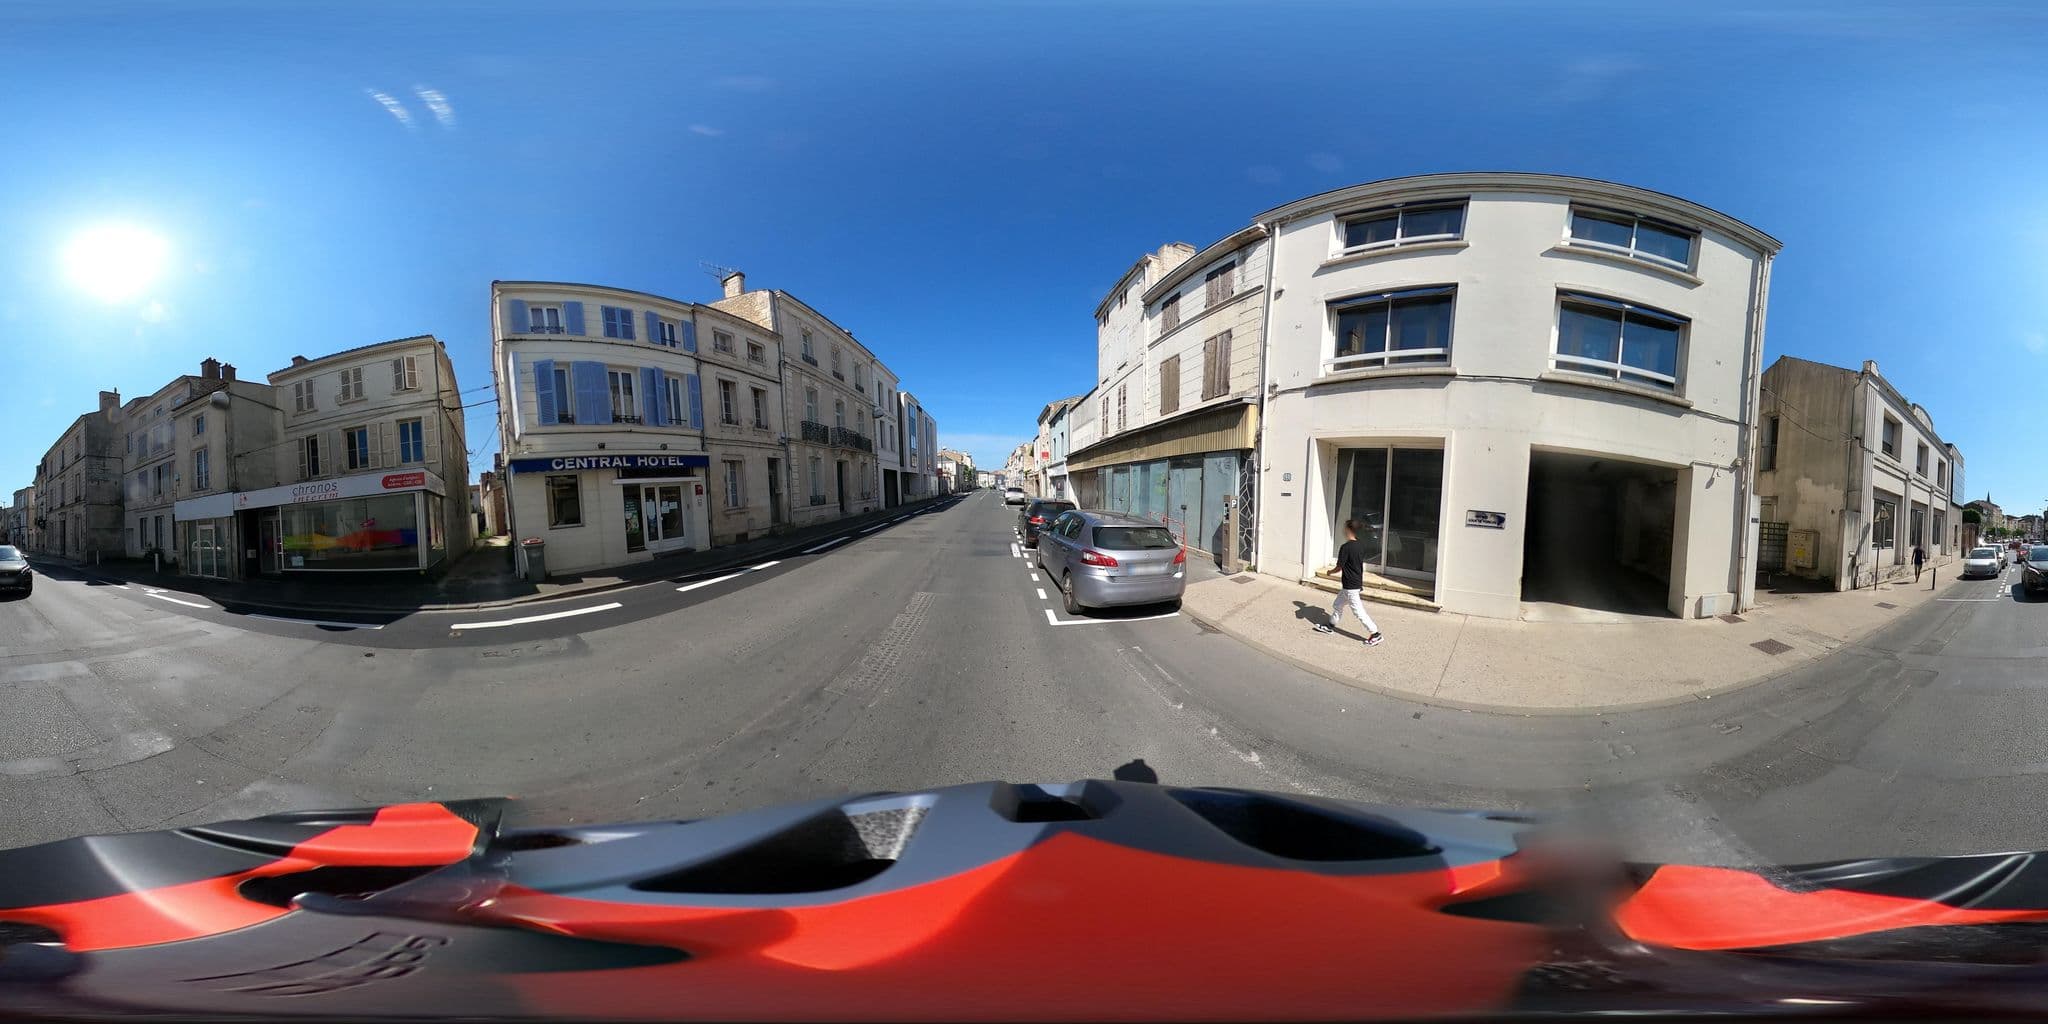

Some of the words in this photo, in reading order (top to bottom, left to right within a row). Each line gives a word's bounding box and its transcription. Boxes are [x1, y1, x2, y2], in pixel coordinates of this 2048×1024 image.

[551, 456, 631, 470] CENTRAL
[637, 455, 684, 467] HOTEL
[291, 482, 338, 496] chronos
